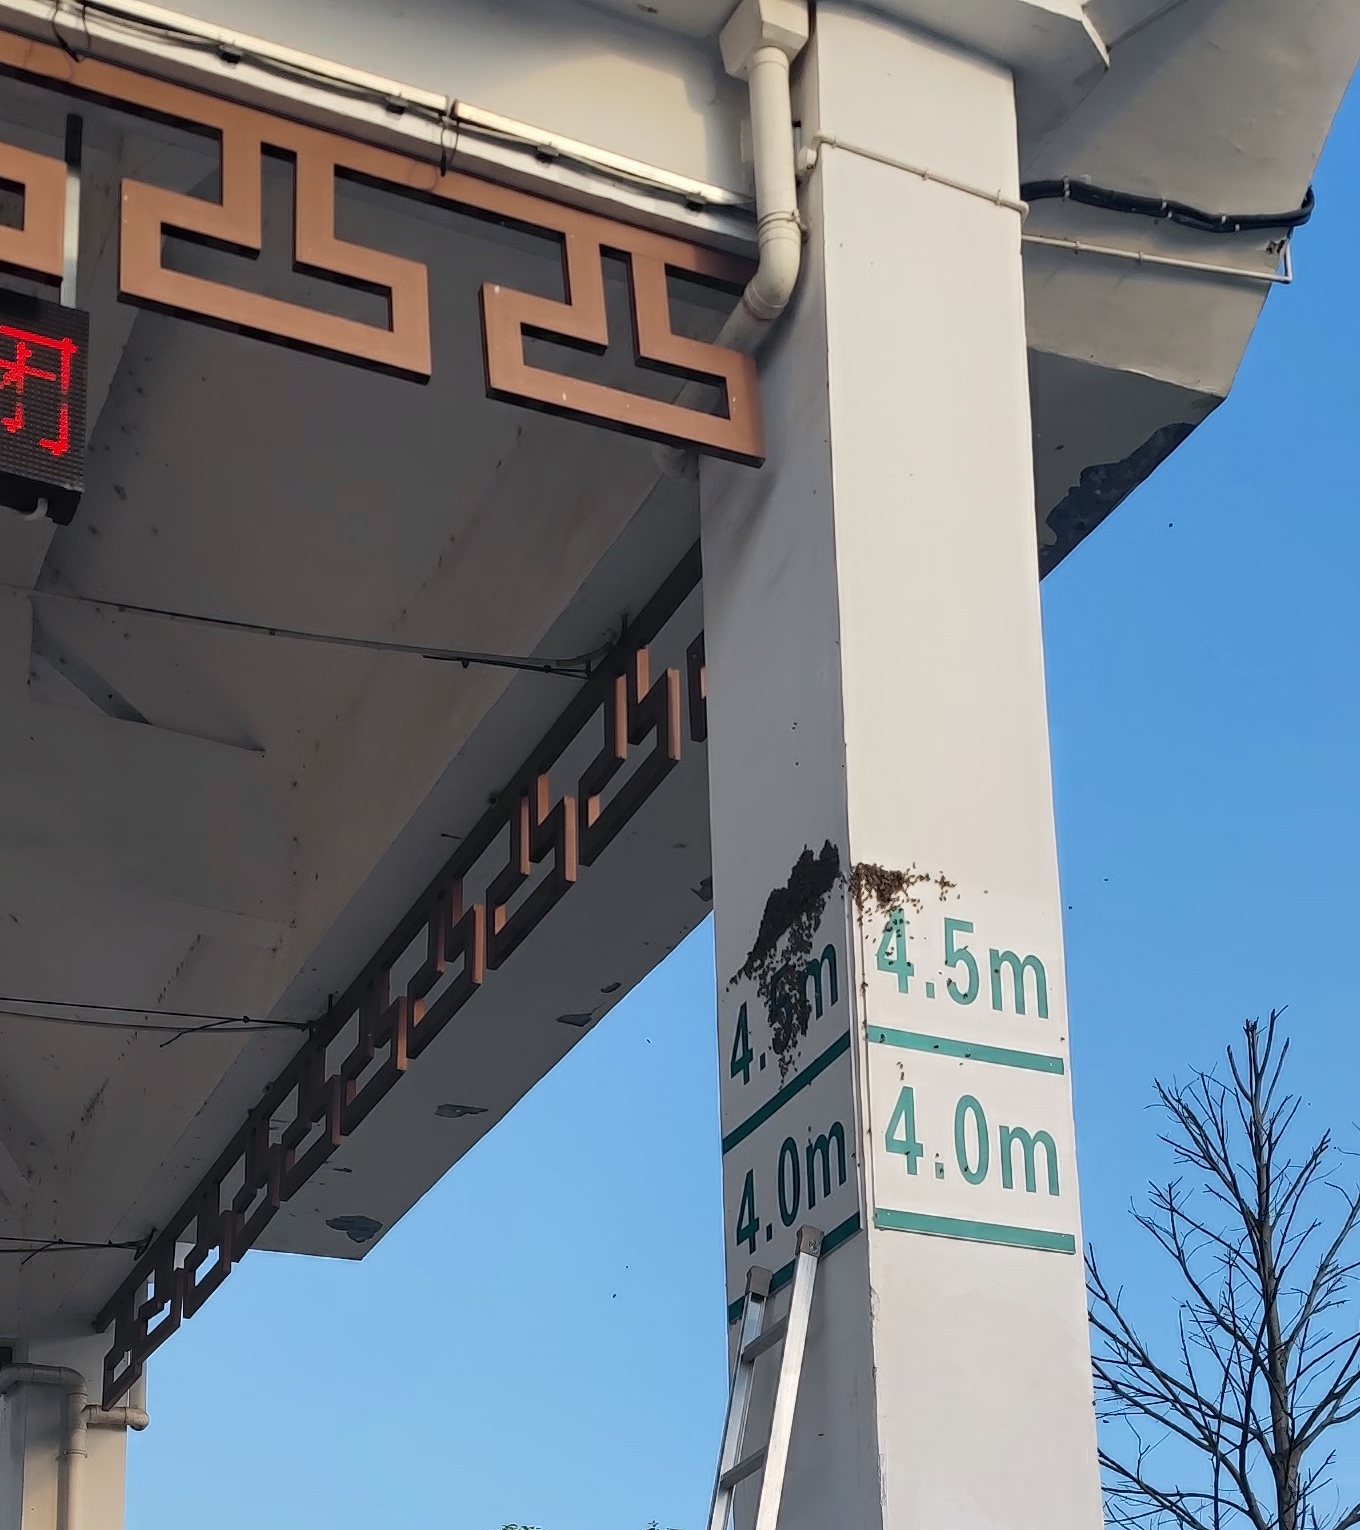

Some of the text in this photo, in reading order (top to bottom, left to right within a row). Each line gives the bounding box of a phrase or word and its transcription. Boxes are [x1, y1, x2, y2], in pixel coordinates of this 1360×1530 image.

[876, 907, 1050, 1020] 4.5m
[735, 1120, 847, 1255] 4.0m
[884, 1085, 1061, 1197] 4.0m
